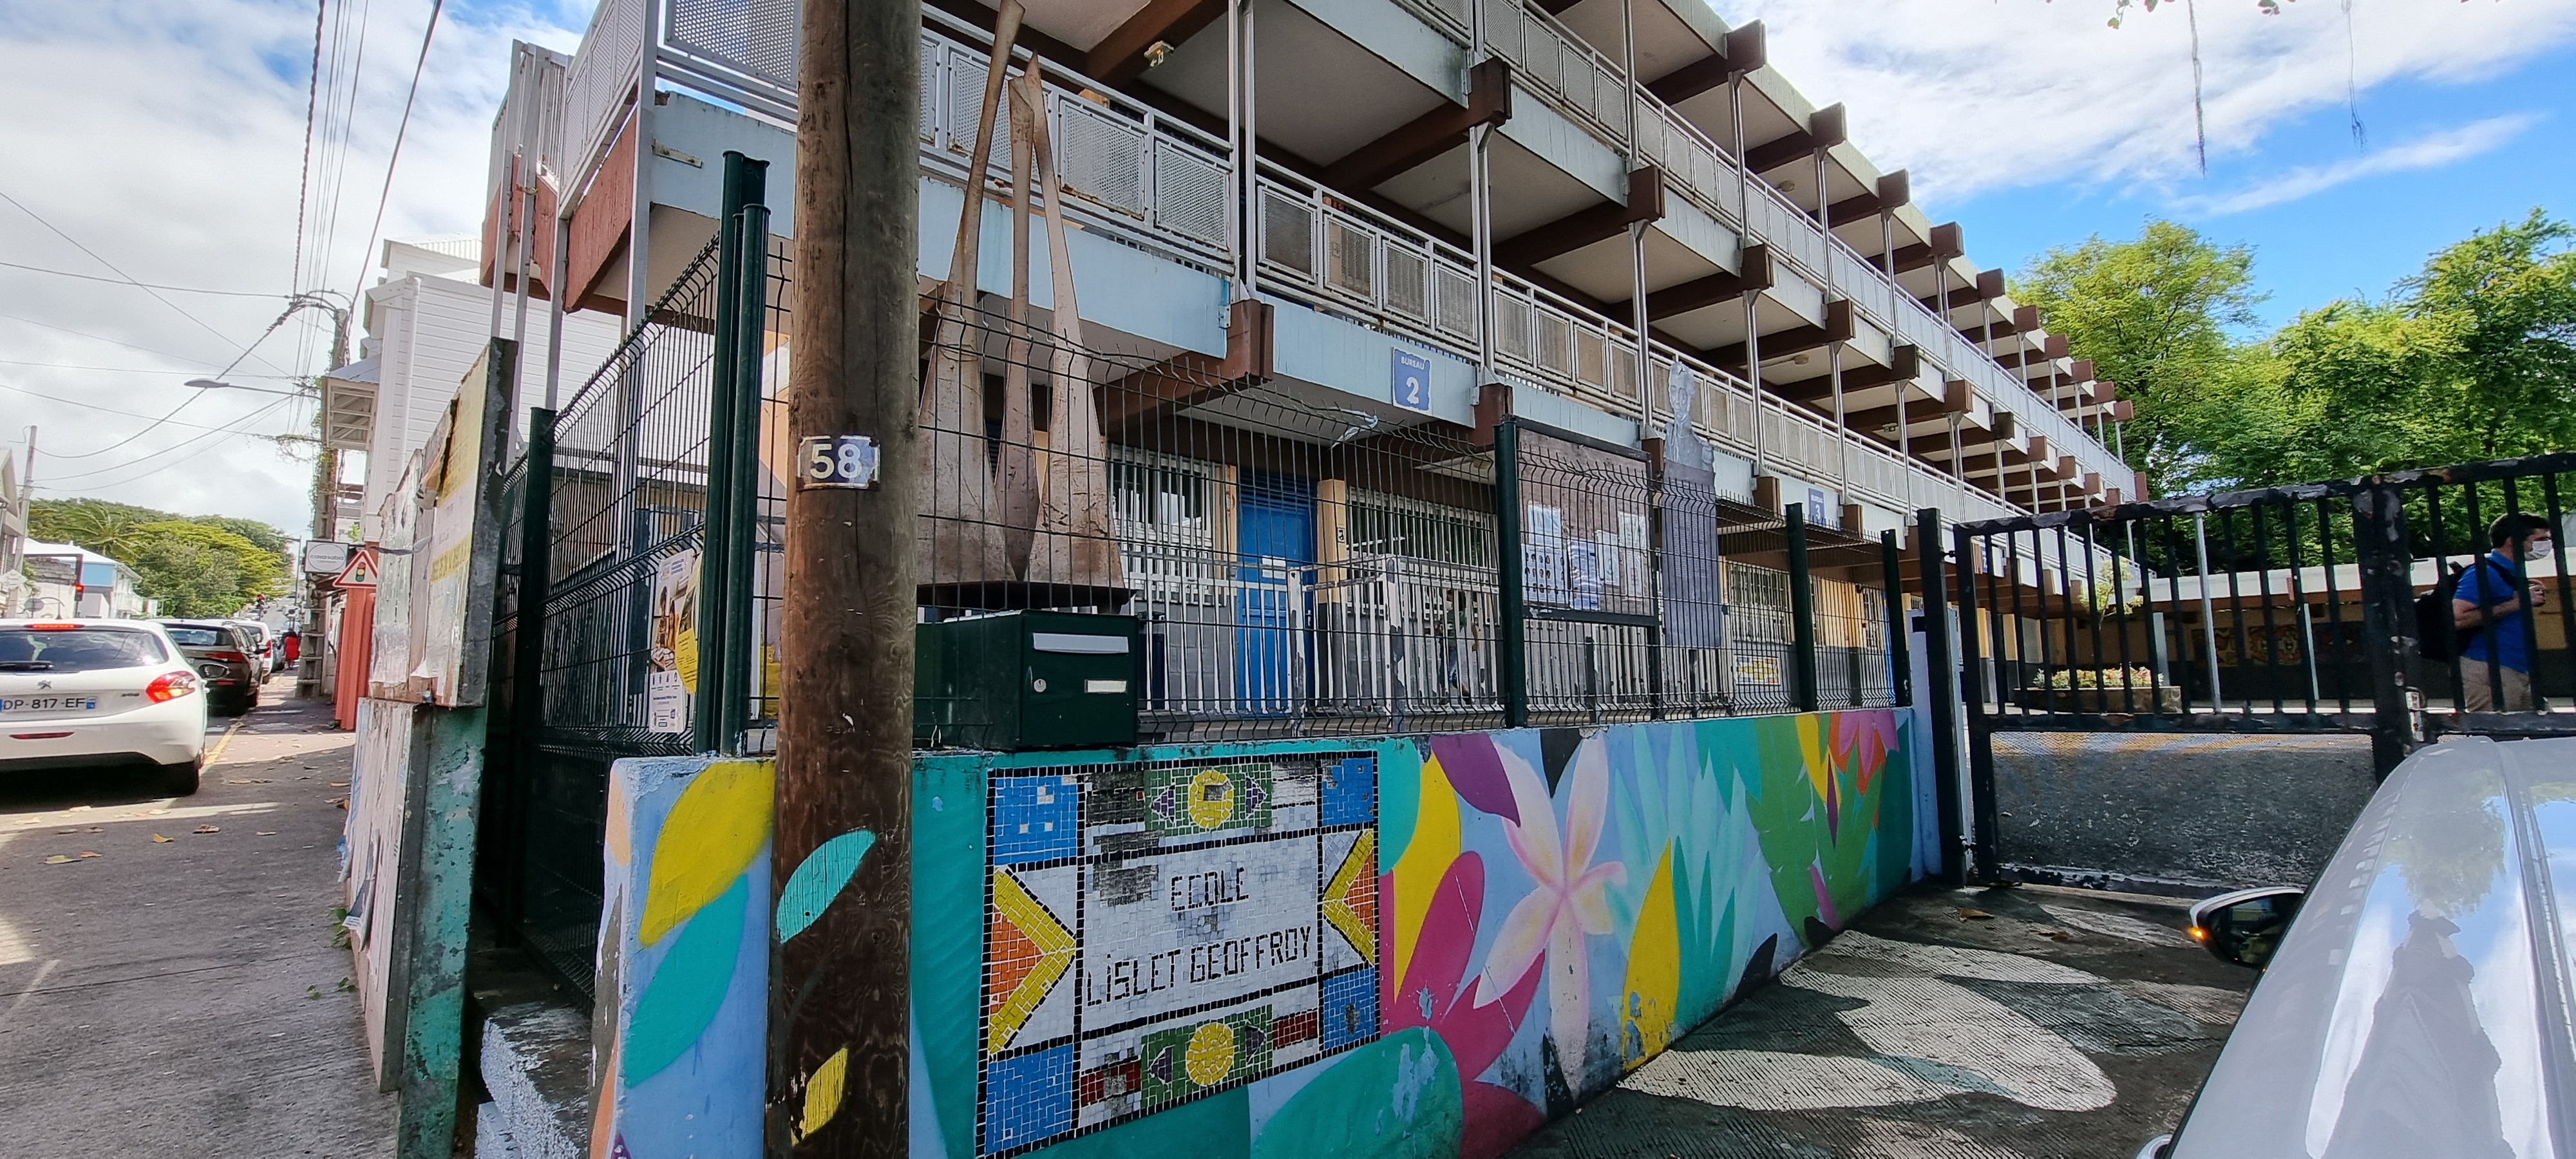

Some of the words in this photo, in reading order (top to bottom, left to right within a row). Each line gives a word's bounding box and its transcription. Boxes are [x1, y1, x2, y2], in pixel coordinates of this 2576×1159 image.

[1401, 356, 1425, 370] BUREAU
[1406, 377, 1419, 404] 2
[810, 444, 862, 479] 58
[1815, 504, 1821, 520] 3
[1171, 867, 1249, 911] ECOLE
[1190, 925, 1311, 983] GEOFFROY
